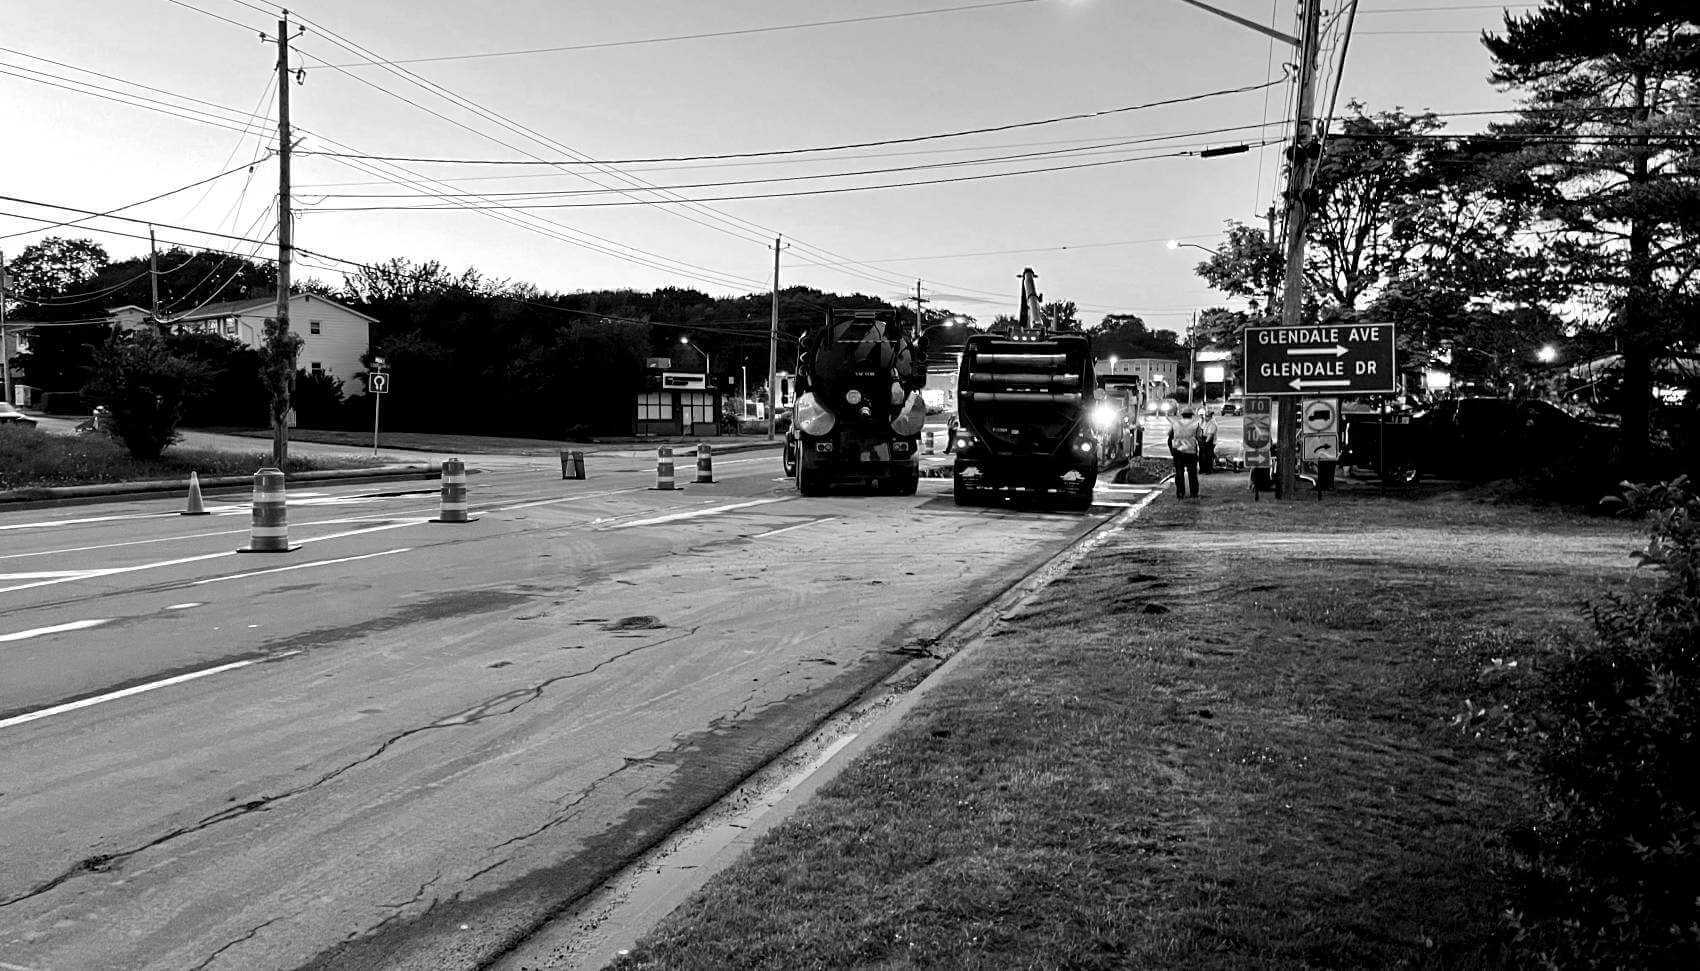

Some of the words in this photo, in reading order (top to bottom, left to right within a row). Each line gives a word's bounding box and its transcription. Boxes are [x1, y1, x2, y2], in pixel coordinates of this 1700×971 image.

[1258, 328, 1339, 345] GLENDALE
[1348, 327, 1380, 342] AVE
[1260, 361, 1345, 377] GLENDALE
[1355, 360, 1377, 375] DR
